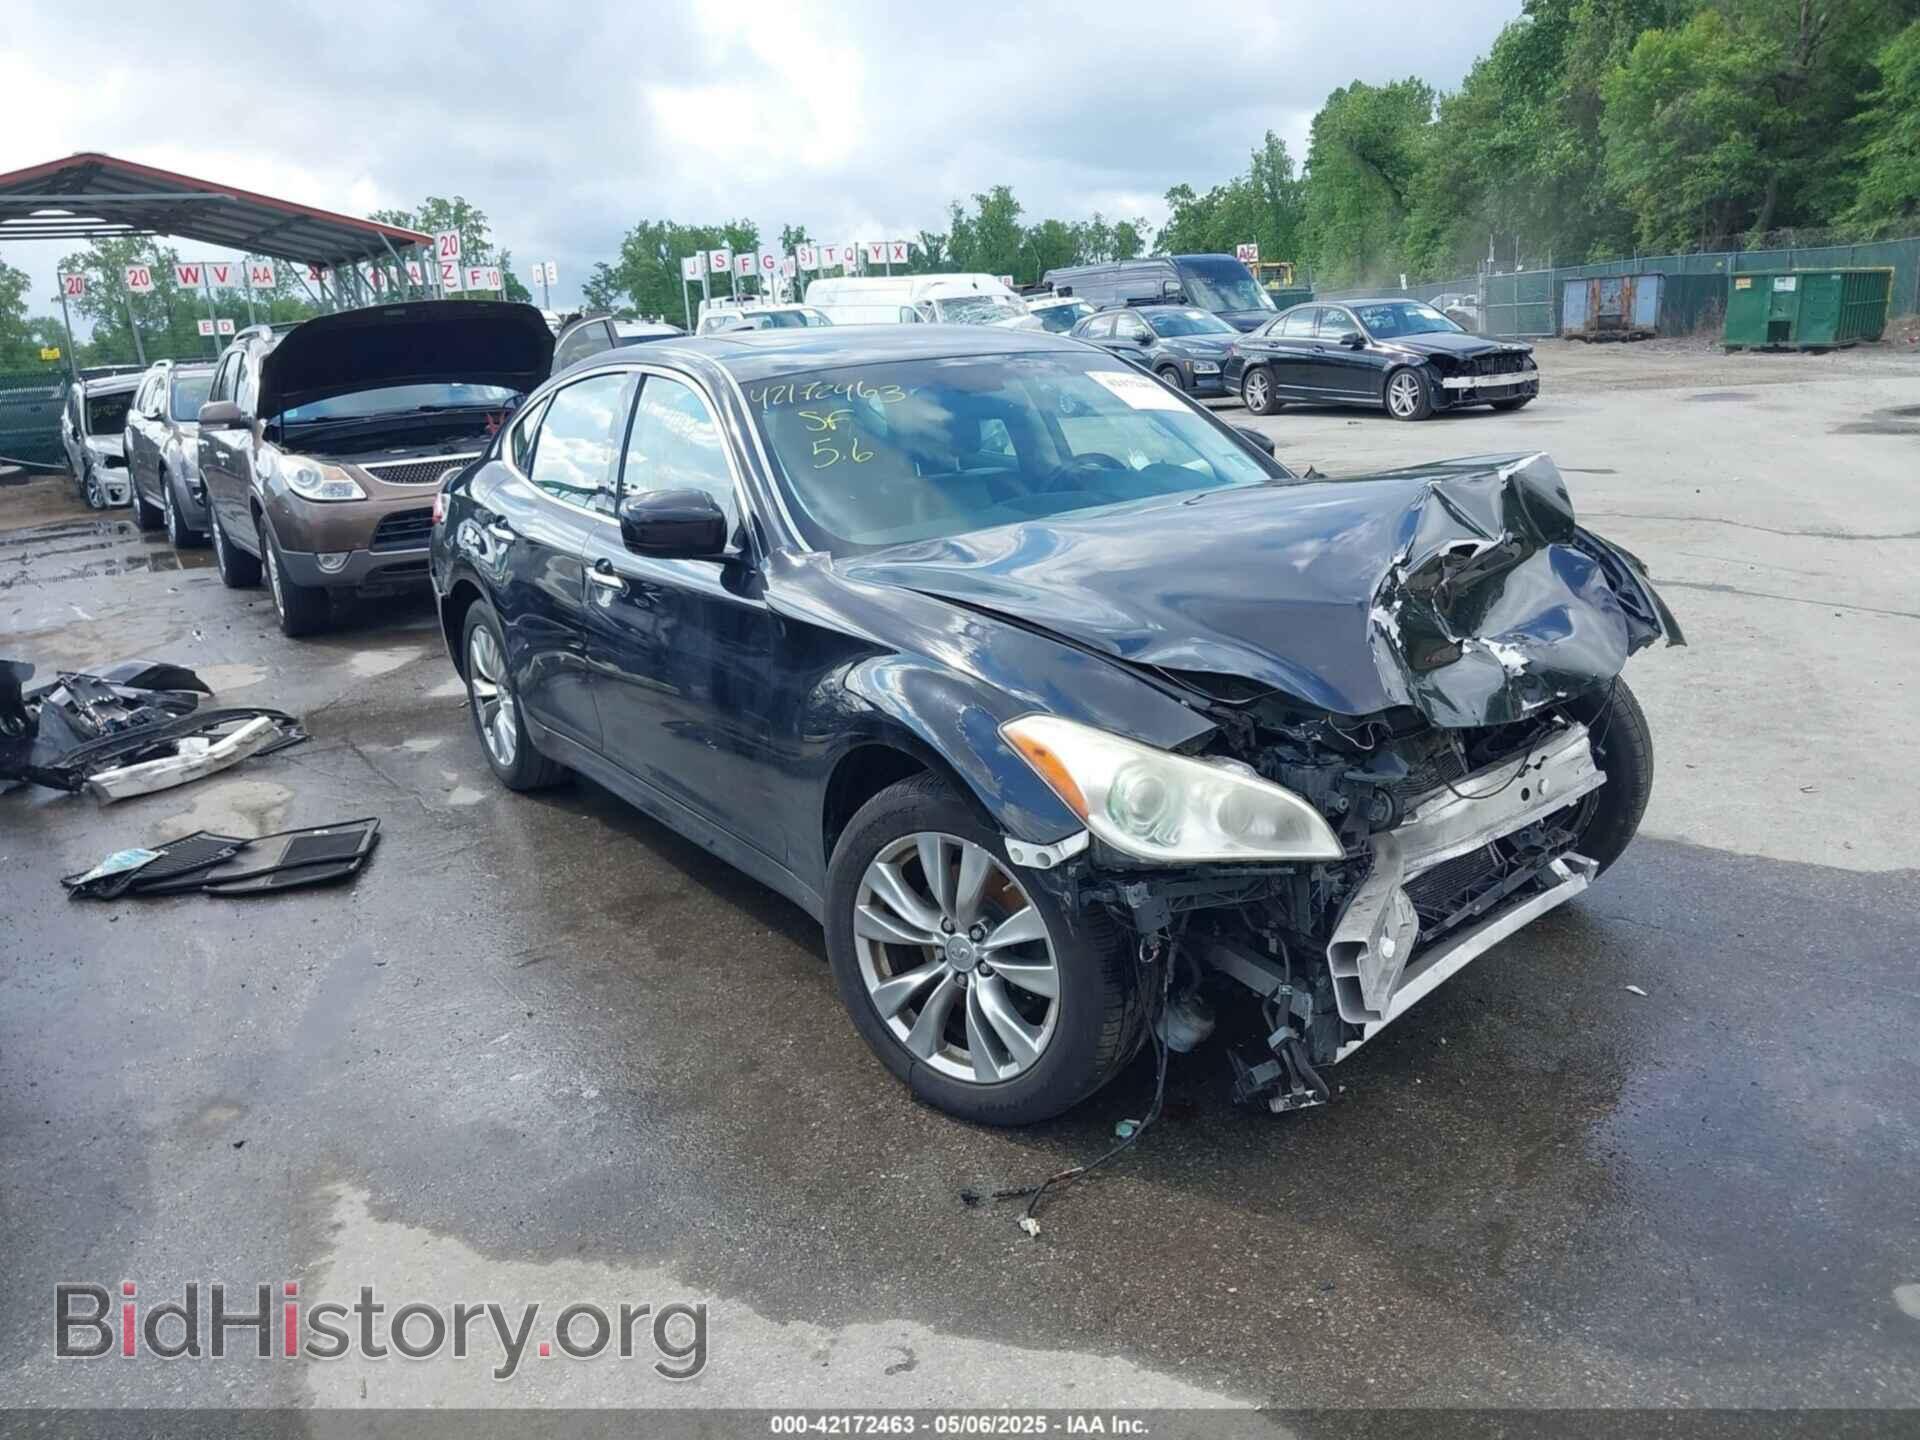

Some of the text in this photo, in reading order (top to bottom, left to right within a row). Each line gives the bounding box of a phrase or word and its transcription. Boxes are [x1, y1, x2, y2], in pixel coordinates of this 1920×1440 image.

[440, 235, 458, 256] 20
[872, 246, 882, 259] Y
[894, 246, 904, 259] X
[715, 254, 726, 268] S
[763, 255, 775, 269] G
[825, 248, 835, 261] T
[441, 264, 455, 280] Z
[740, 258, 750, 272] F
[128, 268, 150, 287] 20
[178, 267, 199, 284] W
[213, 266, 228, 283] V
[251, 266, 273, 283] AA
[471, 270, 481, 286] F
[65, 277, 83, 295] 20
[221, 323, 231, 333] D
[751, 380, 907, 410] 42172463
[812, 438, 874, 469] 5.6
